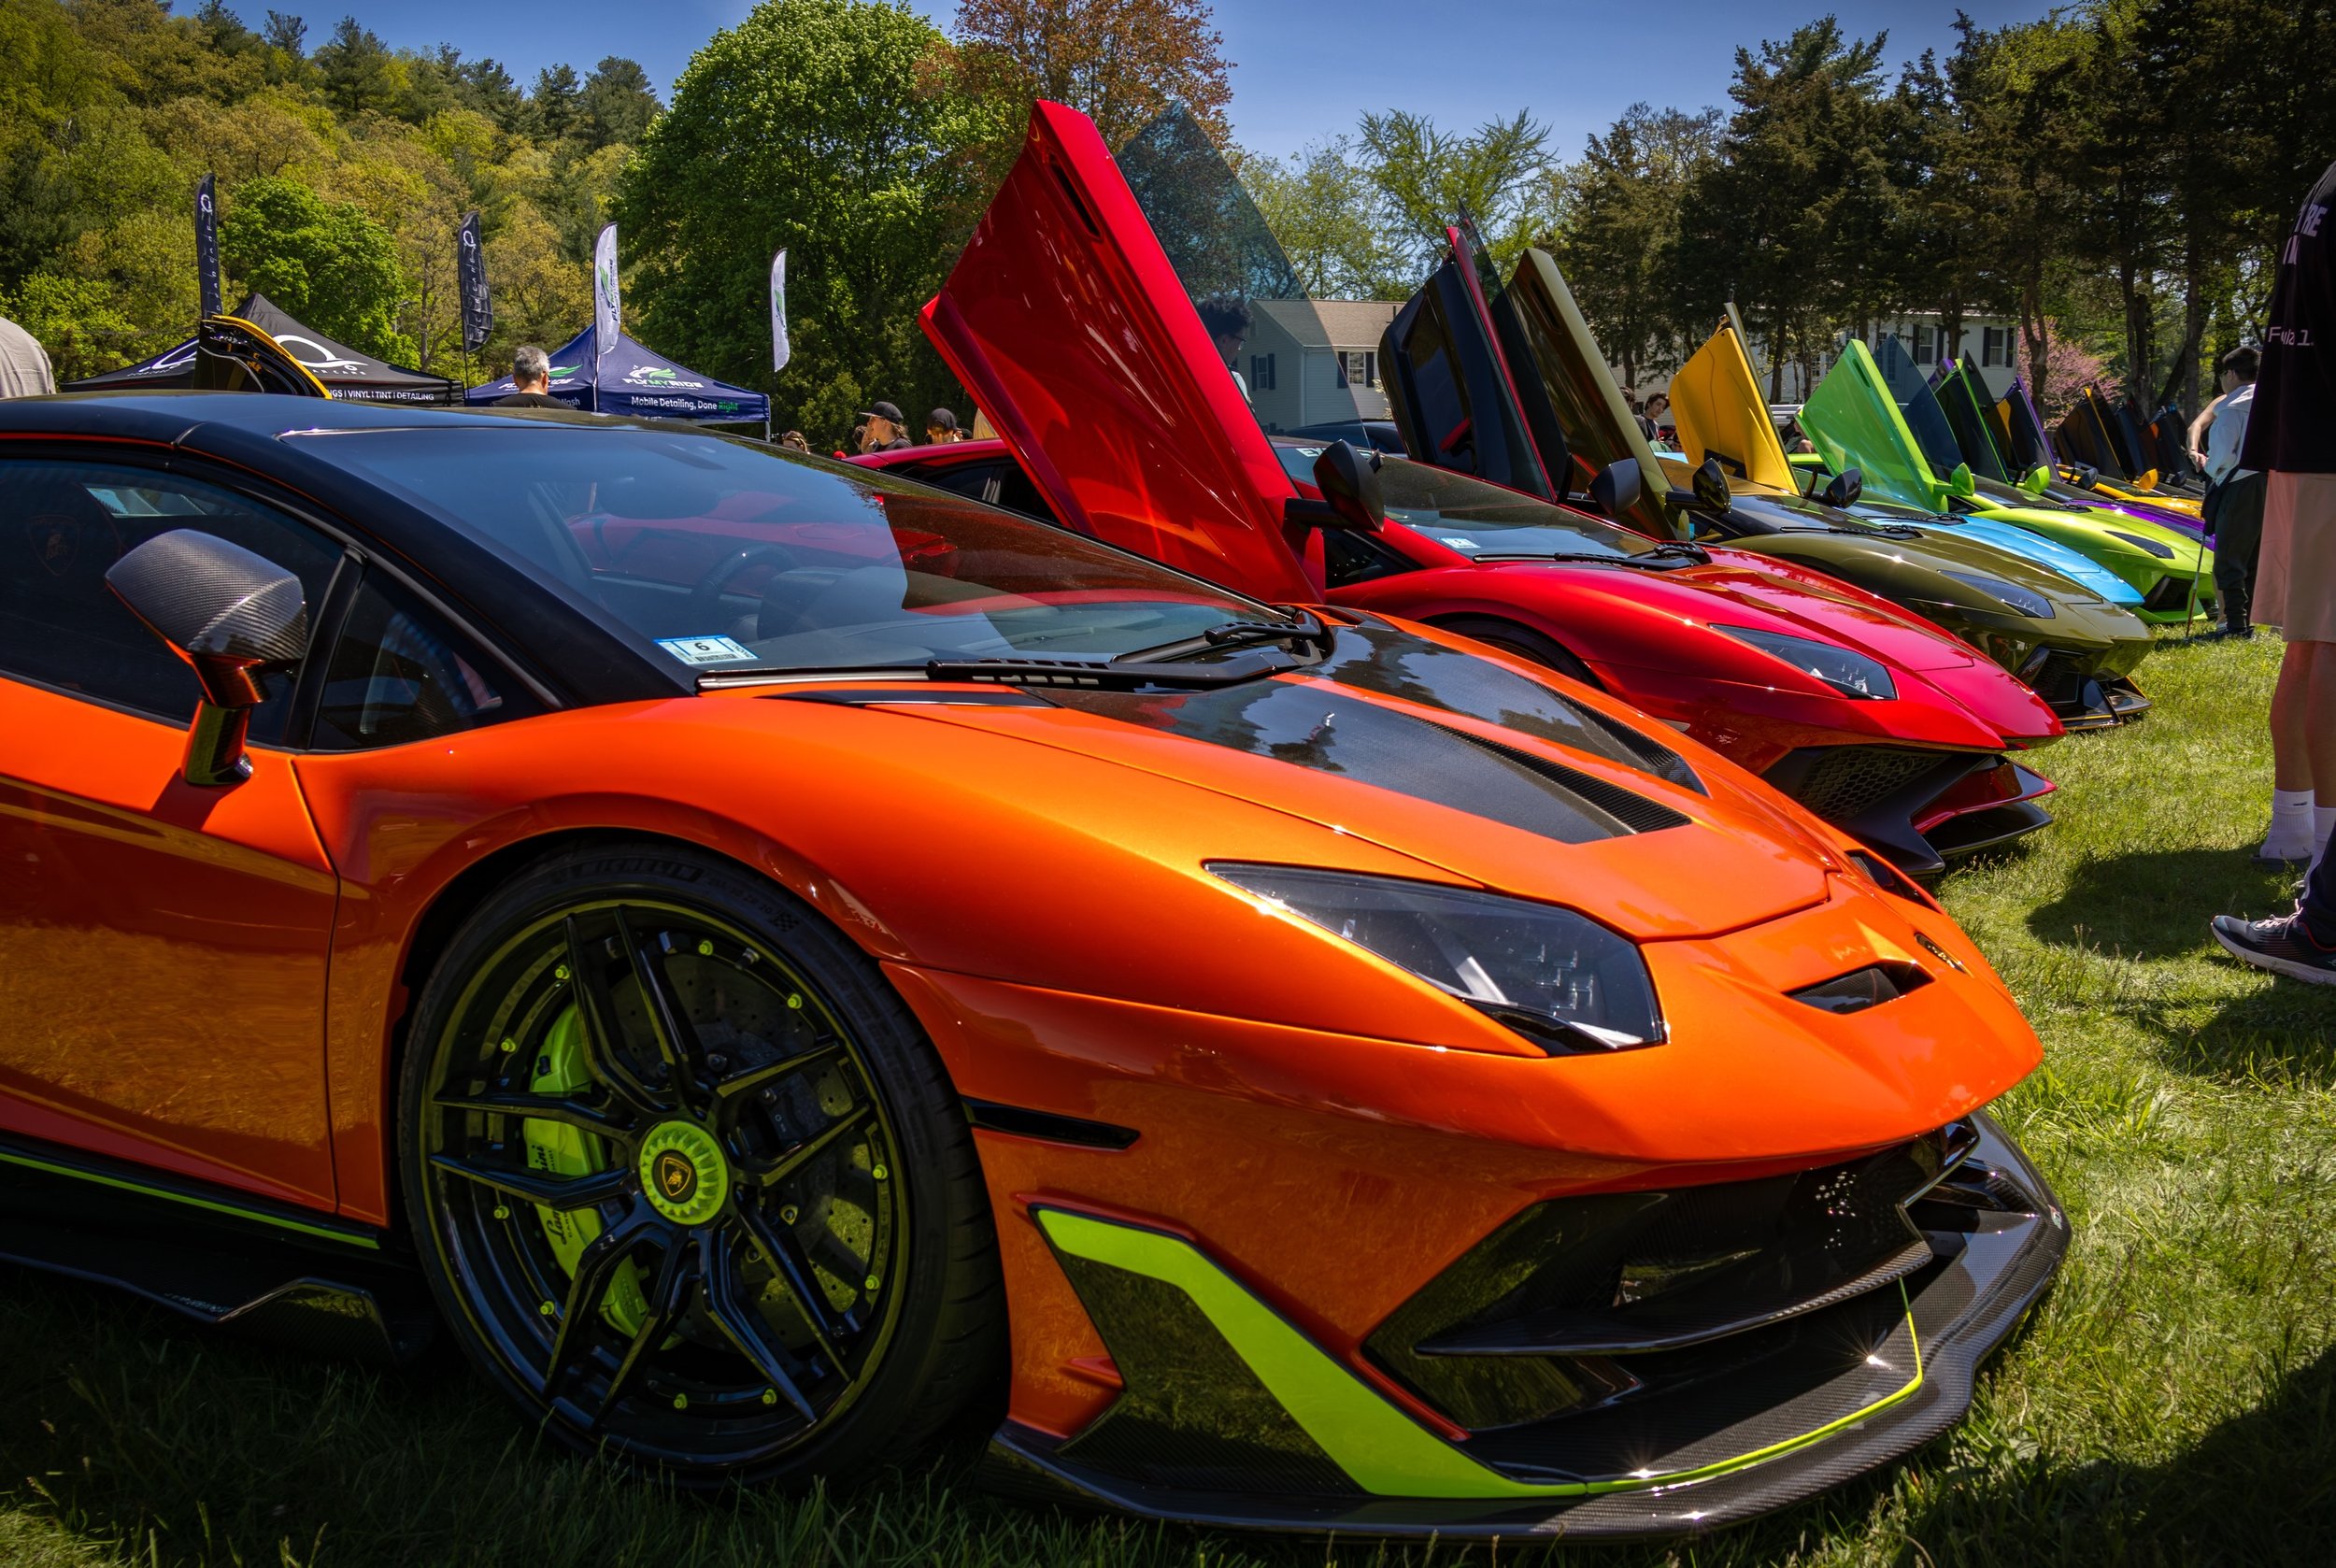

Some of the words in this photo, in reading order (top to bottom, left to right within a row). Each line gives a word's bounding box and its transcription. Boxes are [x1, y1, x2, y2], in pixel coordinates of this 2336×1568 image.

[347, 390, 371, 399] VINYL
[375, 392, 392, 400] TINT
[396, 392, 434, 401] DETAILING
[631, 395, 659, 406] Mobile
[659, 396, 697, 410] Detailing,
[698, 399, 718, 410] Done
[719, 401, 738, 413] Right
